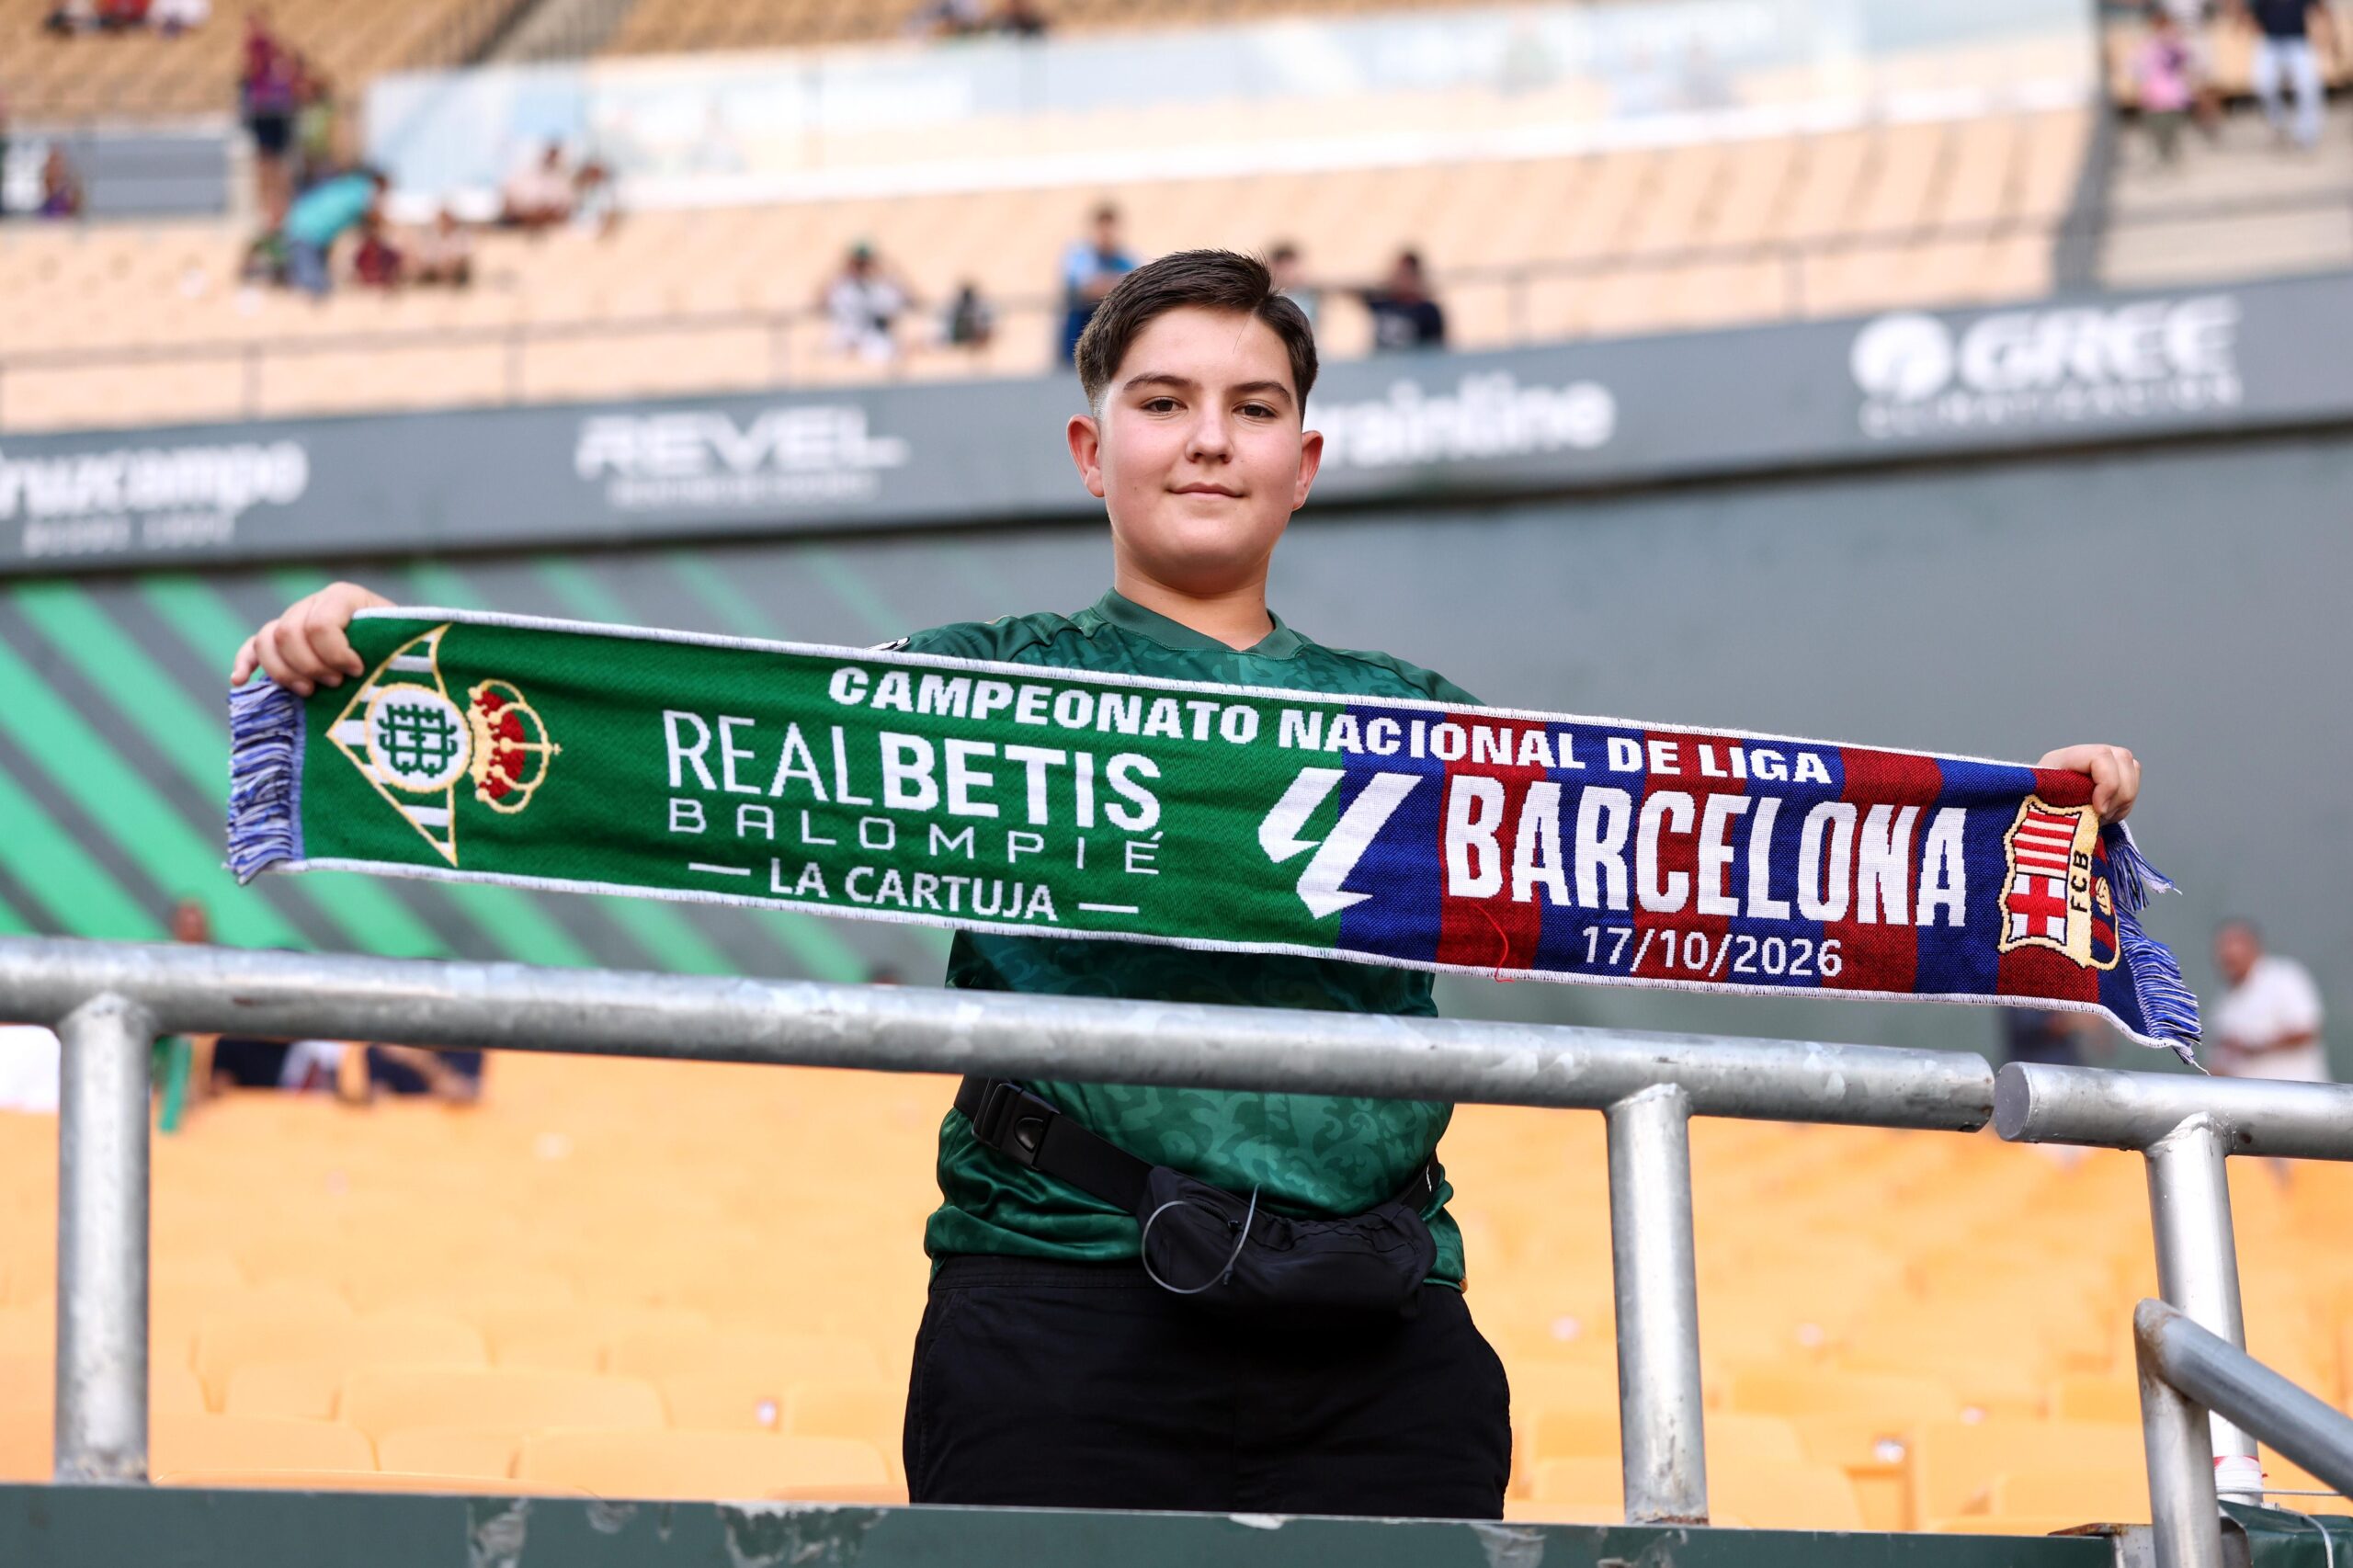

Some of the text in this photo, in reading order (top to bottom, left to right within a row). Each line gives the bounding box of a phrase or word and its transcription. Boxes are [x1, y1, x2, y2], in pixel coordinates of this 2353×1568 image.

[1959, 292, 2240, 393] GREE
[576, 406, 904, 480] REVEL
[1305, 372, 1615, 467] rainline
[0, 442, 308, 519] ruzcampo
[828, 667, 1833, 786] CAMPEONATO NACIONAL DE LIGA
[668, 797, 1161, 875] BALOMPIÉ
[1445, 774, 1967, 927] BARCELONA
[769, 858, 1059, 923] LA CARTUJA
[2070, 849, 2089, 914] FCB
[1582, 925, 1844, 978] 17/10/2026
